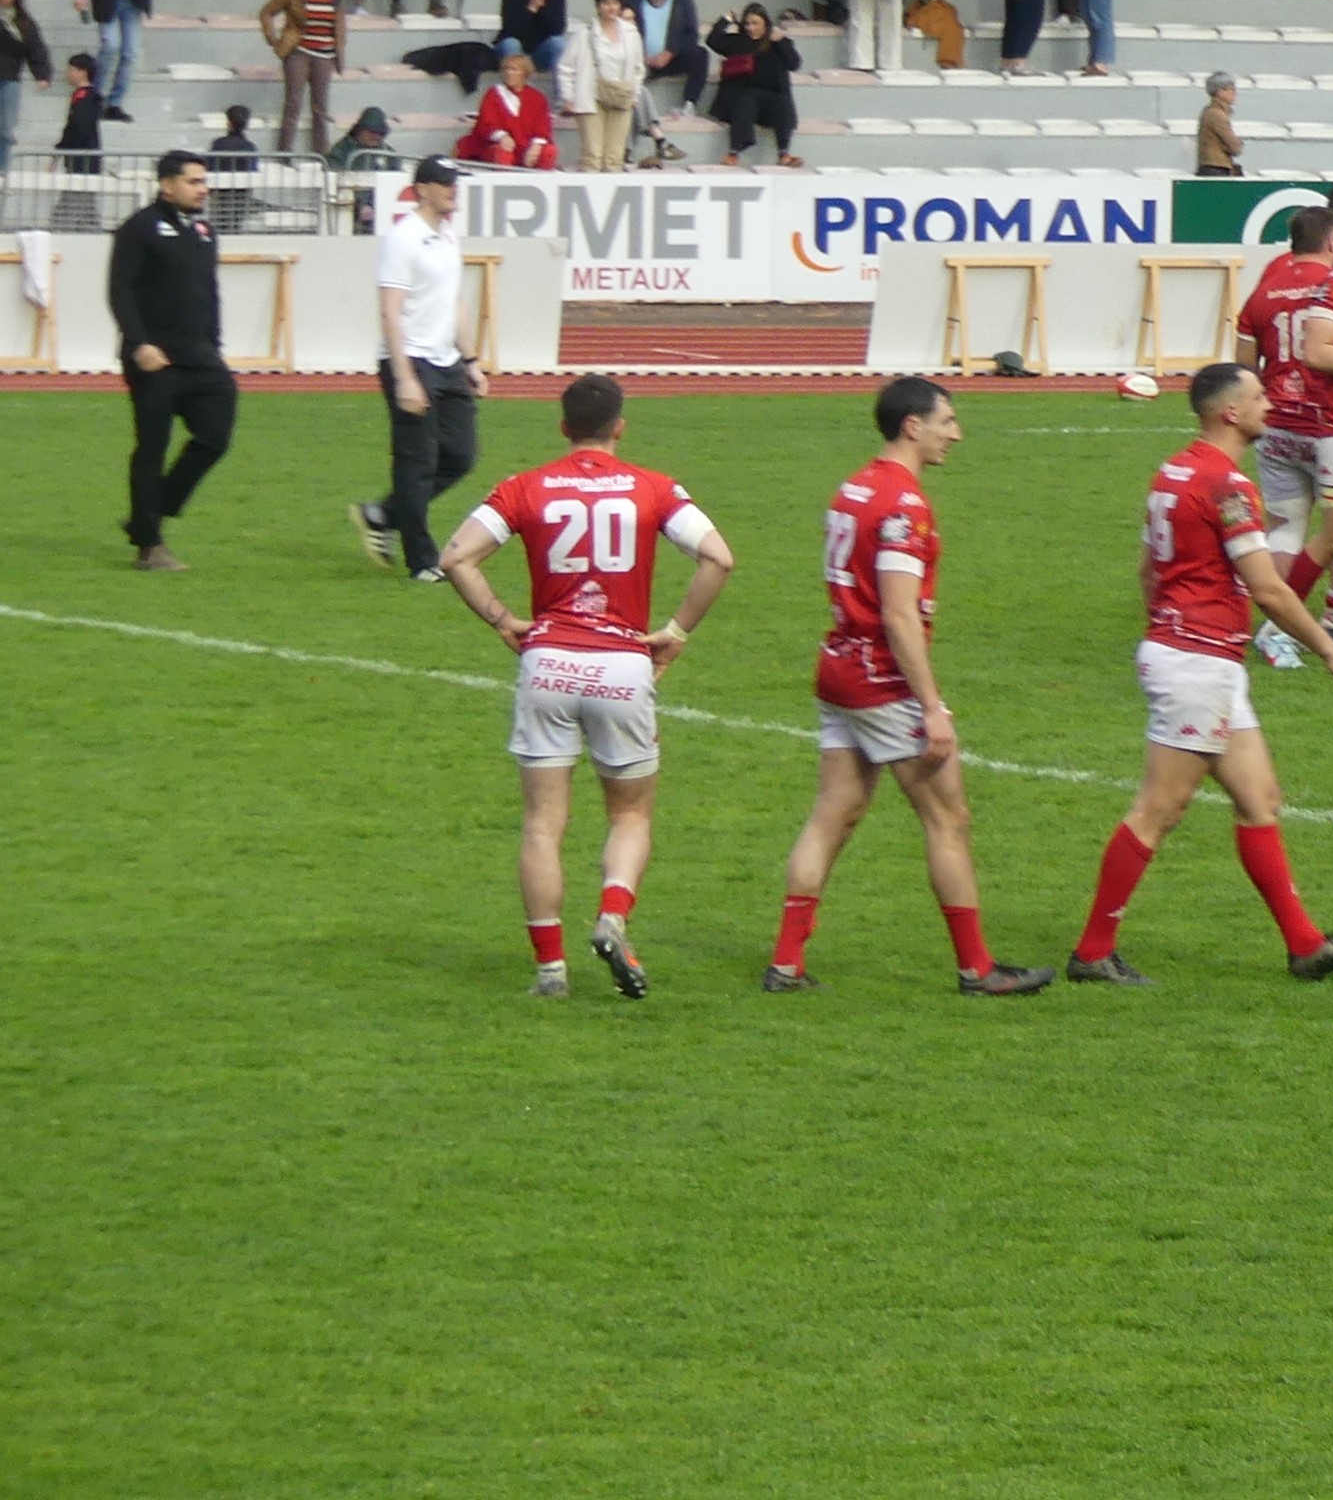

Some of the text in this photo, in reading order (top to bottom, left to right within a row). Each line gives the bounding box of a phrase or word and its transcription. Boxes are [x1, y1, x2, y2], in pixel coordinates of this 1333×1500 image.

[815, 197, 1156, 254] PROMAN
[572, 267, 691, 291] METAUX
[543, 498, 637, 573] 20
[535, 657, 608, 680] FRANCE
[530, 676, 636, 701] PARE-BRISE
